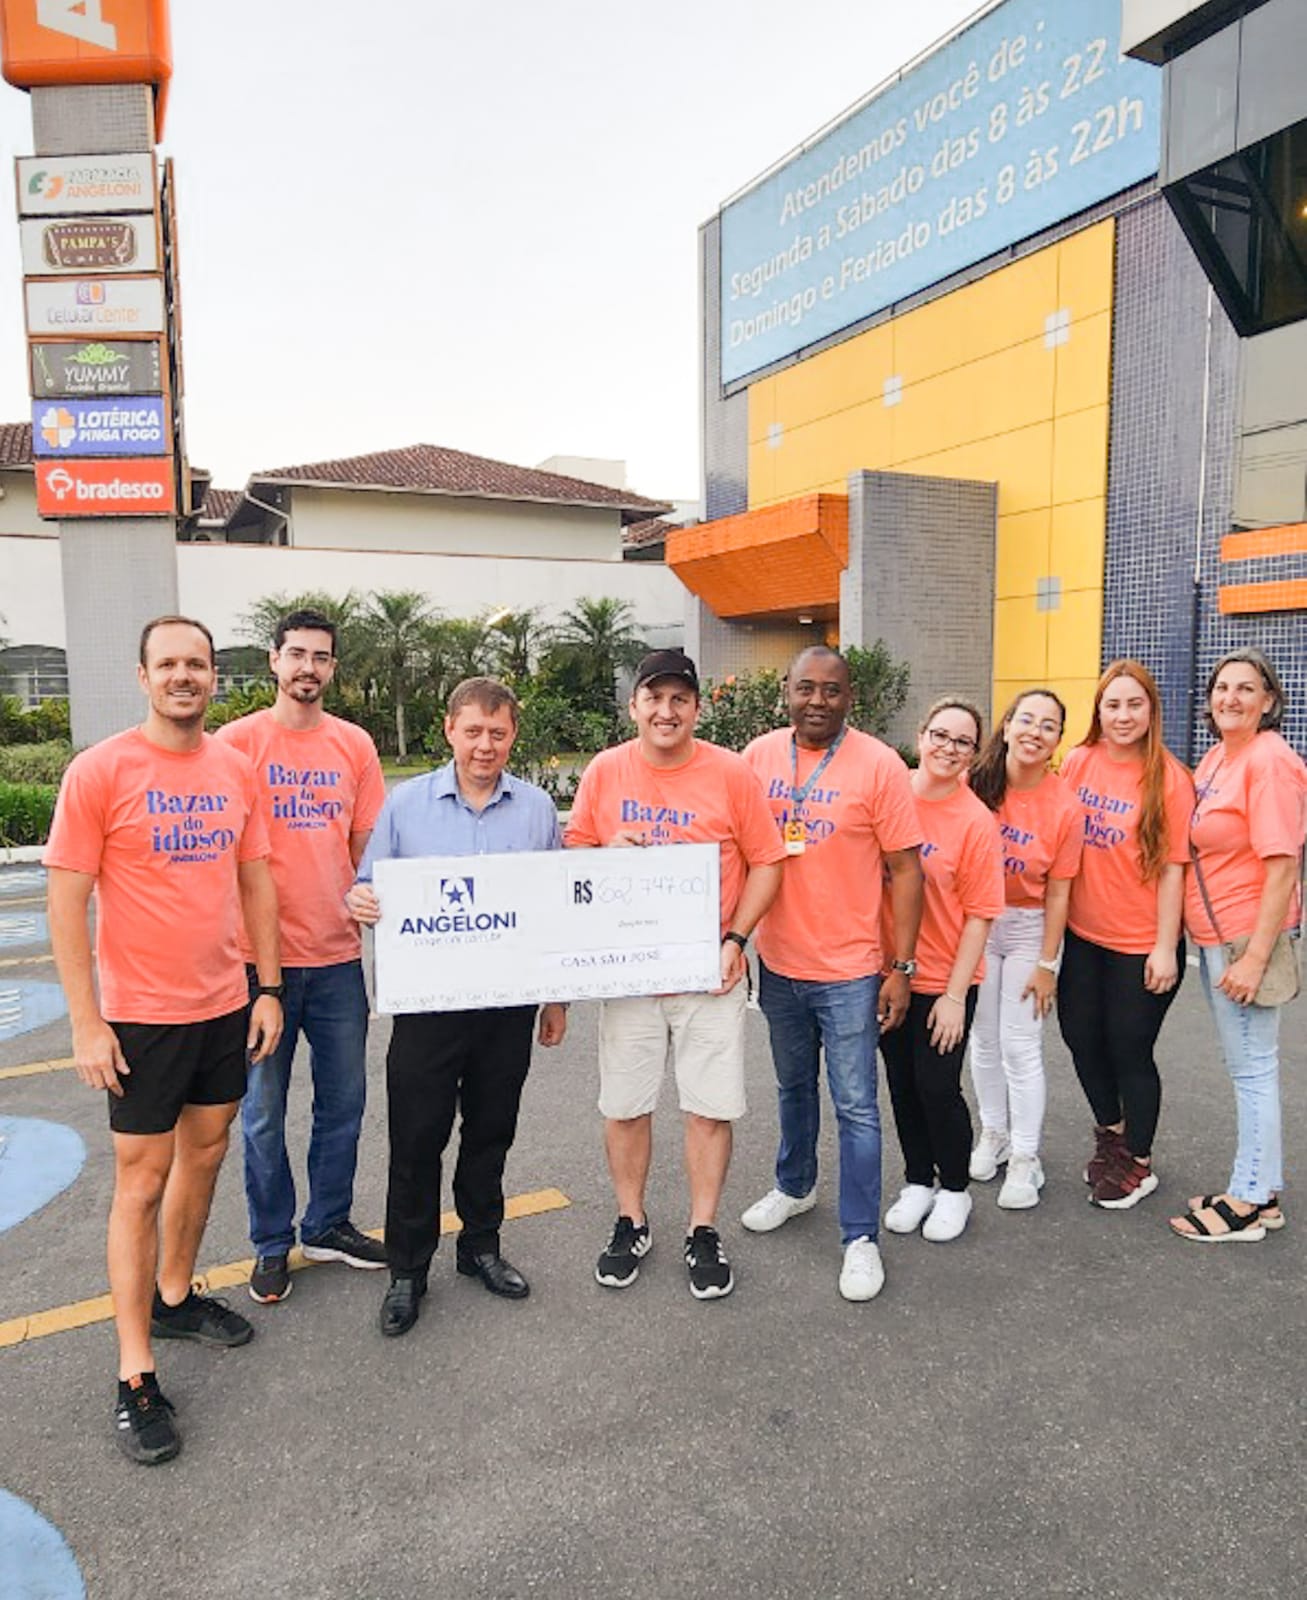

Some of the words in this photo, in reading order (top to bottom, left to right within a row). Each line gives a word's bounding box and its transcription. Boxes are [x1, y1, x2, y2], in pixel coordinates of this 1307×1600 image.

[779, 117, 907, 227] Atendemos
[913, 61, 980, 132] você
[66, 182, 142, 198] ANGELONI
[730, 215, 813, 301] Segunda
[817, 223, 831, 251] a
[835, 165, 924, 239] Sábado
[931, 126, 981, 178] das
[988, 103, 1008, 143] 8
[1016, 80, 1051, 127] às
[729, 286, 817, 348] Domingo
[822, 275, 835, 299] e
[839, 221, 931, 291] Feriado
[938, 187, 988, 236] das
[997, 163, 1015, 205] 8
[1024, 145, 1060, 190] às
[1069, 96, 1143, 166] 22h
[60, 236, 120, 250] PAMPA'S
[64, 365, 129, 383] YUMMY
[78, 407, 160, 428] LOTÉRICA
[78, 430, 121, 442] PINGA
[122, 428, 161, 441] FOGO
[76, 477, 164, 499] bradesco
[269, 764, 341, 787] Bazar
[146, 790, 228, 814] Bazar
[622, 799, 696, 826] Bazar
[183, 815, 204, 832] do
[651, 824, 670, 838] do
[399, 911, 518, 935] ANGELONI
